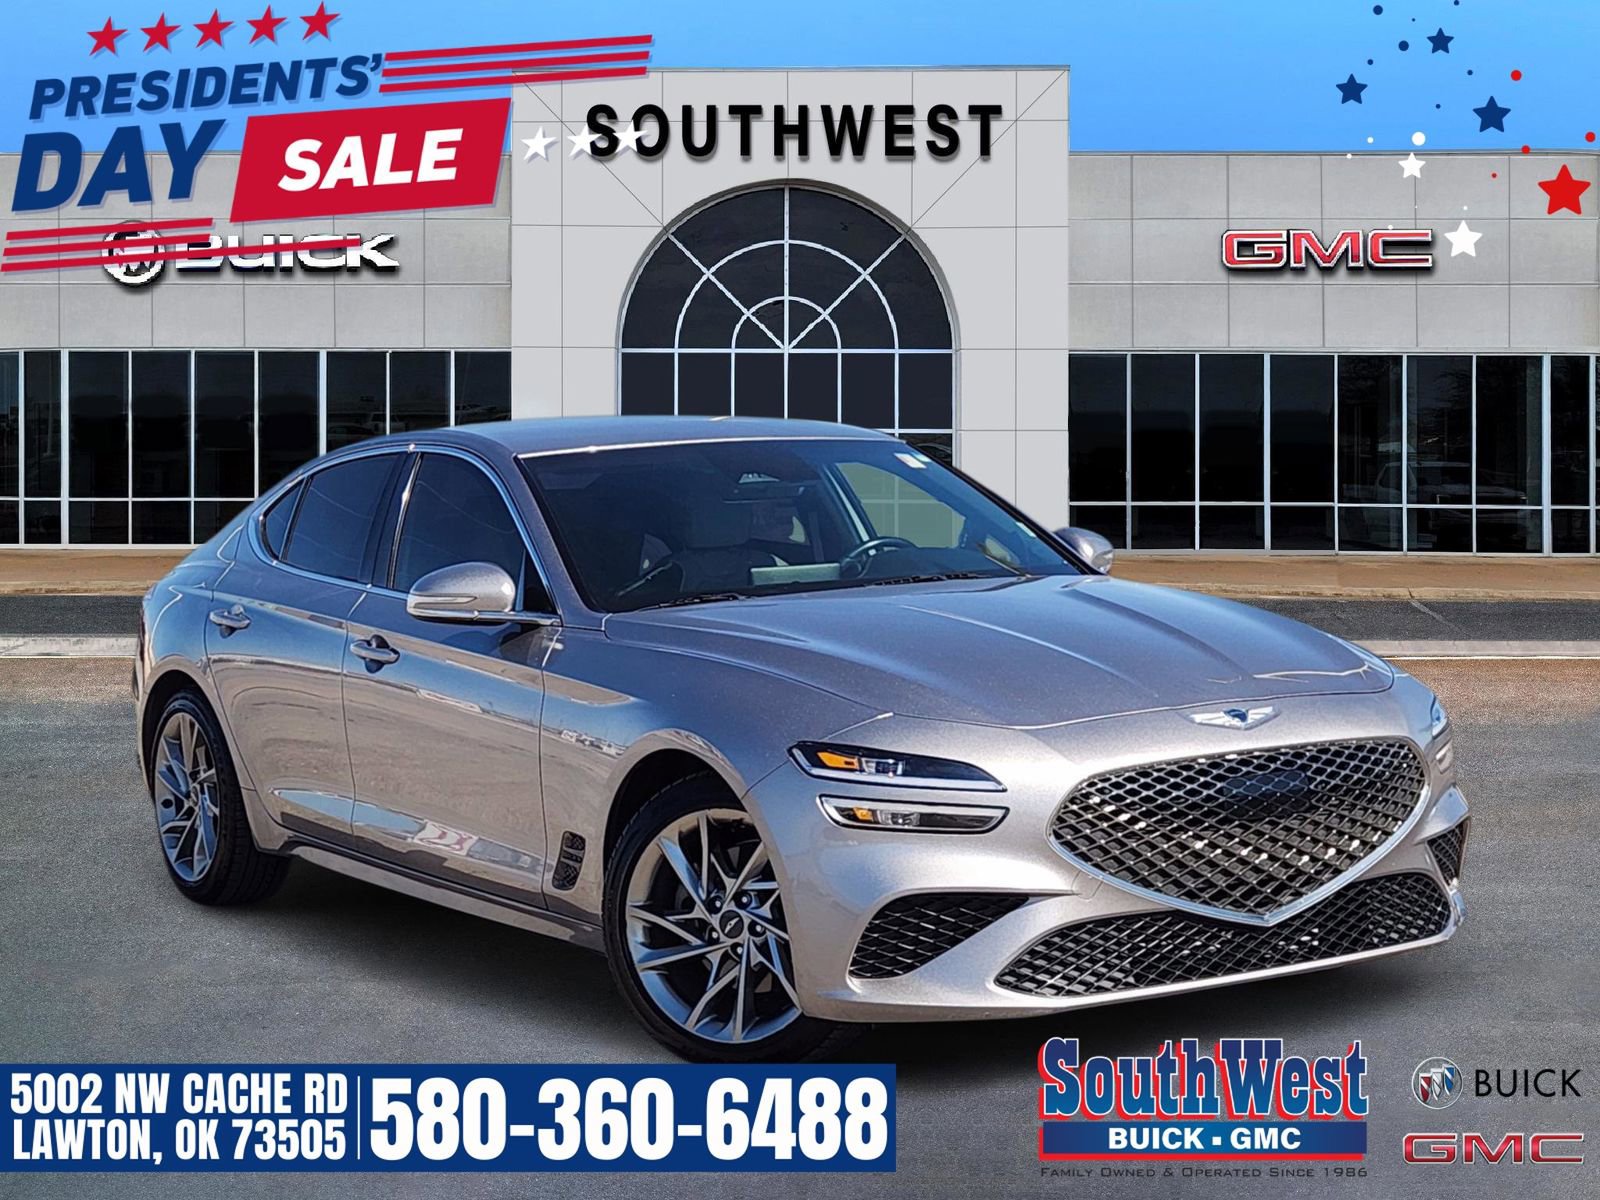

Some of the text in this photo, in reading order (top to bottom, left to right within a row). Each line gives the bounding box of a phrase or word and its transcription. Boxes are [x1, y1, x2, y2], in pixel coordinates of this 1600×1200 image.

[586, 103, 1004, 159] SOUTHWEST
[174, 232, 400, 272] BUICK
[1221, 229, 1434, 271] GMC
